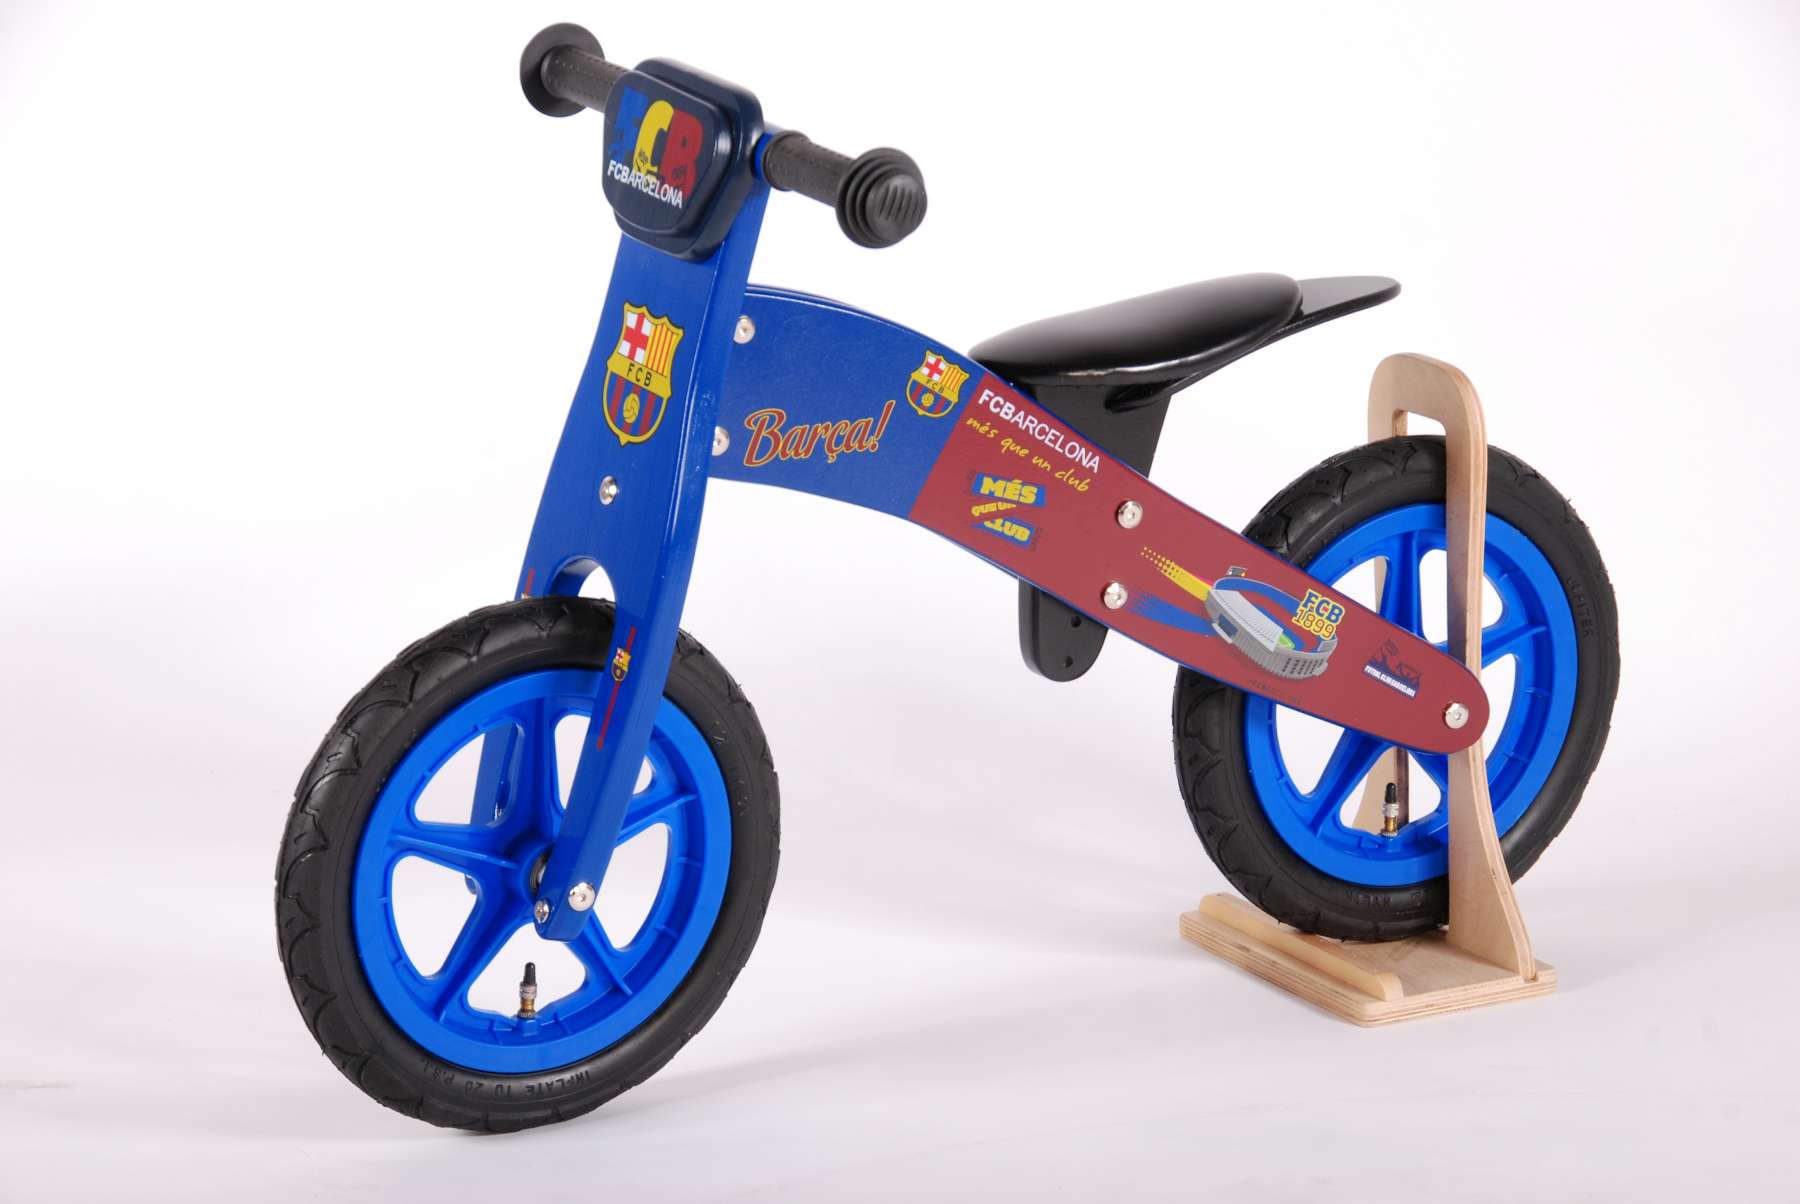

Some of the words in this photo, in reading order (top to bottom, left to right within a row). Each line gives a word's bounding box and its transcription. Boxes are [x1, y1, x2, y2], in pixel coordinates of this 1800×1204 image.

[607, 159, 683, 208] FCBARCELONA
[627, 362, 653, 387] FCB
[926, 378, 945, 394] FCB
[743, 399, 897, 468] Barça!
[978, 388, 1101, 474] FCBARCELONA
[966, 417, 999, 439] més
[1000, 437, 1030, 457] que
[1031, 455, 1052, 472] un
[1054, 468, 1091, 493] club
[980, 476, 1038, 504] MÉS
[1292, 606, 1336, 639] 1899
[1301, 590, 1345, 625] FCB
[464, 1080, 484, 1094] 20
[526, 1069, 591, 1097] INFLATE
